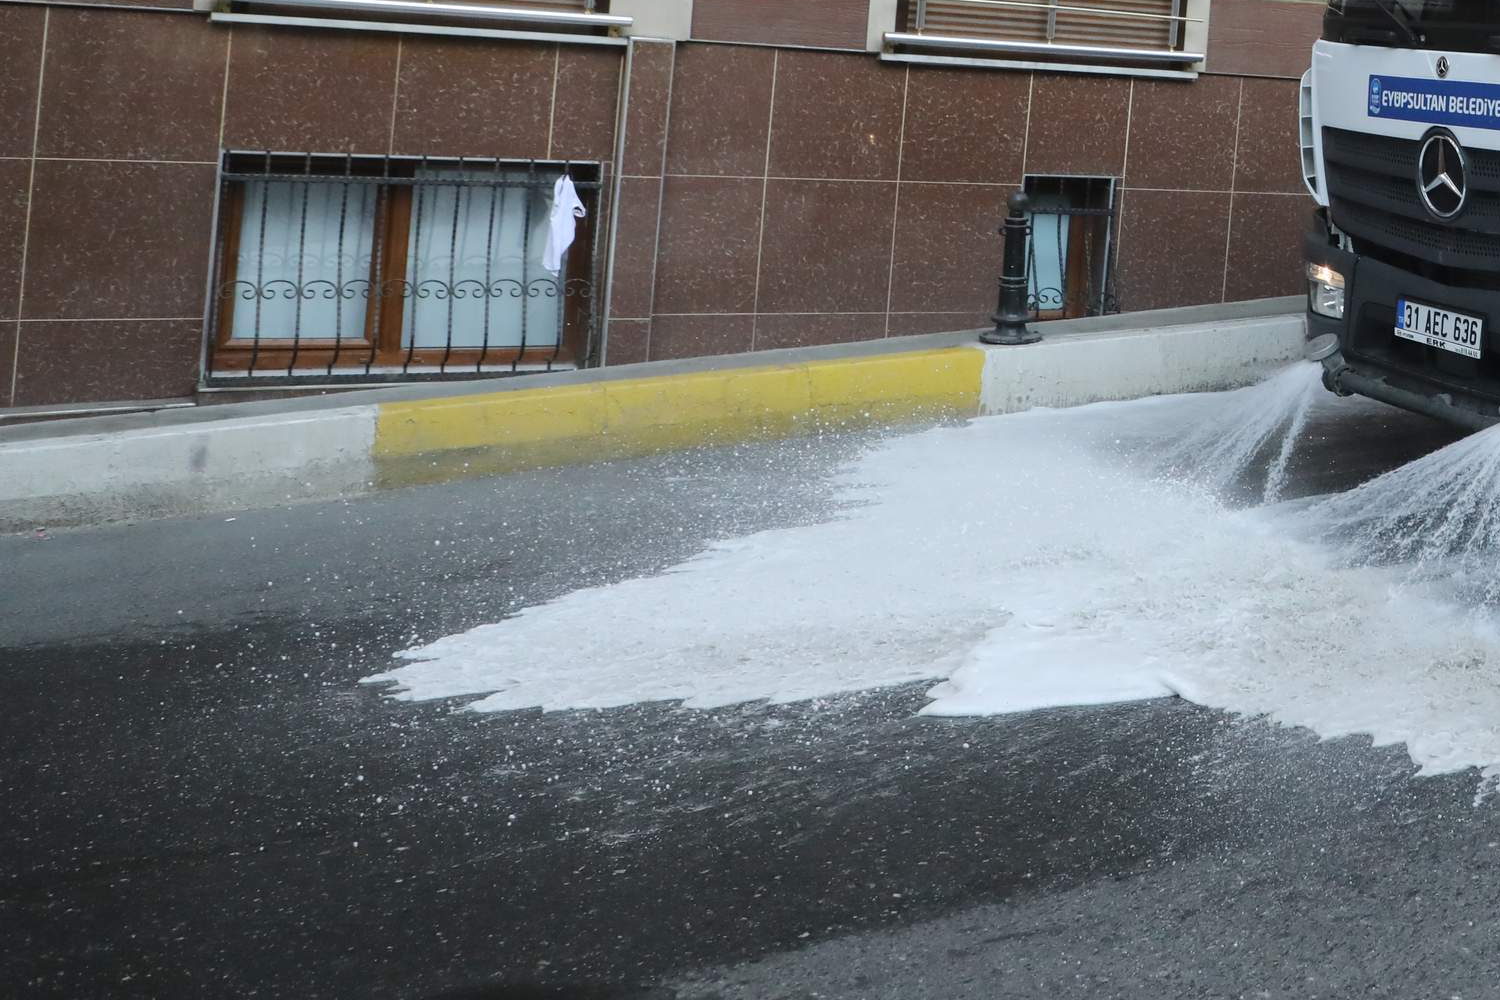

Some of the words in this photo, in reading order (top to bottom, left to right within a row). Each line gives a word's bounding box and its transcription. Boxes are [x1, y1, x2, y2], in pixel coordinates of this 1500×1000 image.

[1381, 90, 1447, 113] EYÜPSULTAN
[1405, 304, 1419, 330] 31
[1424, 309, 1448, 338] AEC
[1453, 316, 1478, 346] 636
[1426, 337, 1446, 349] ERK
